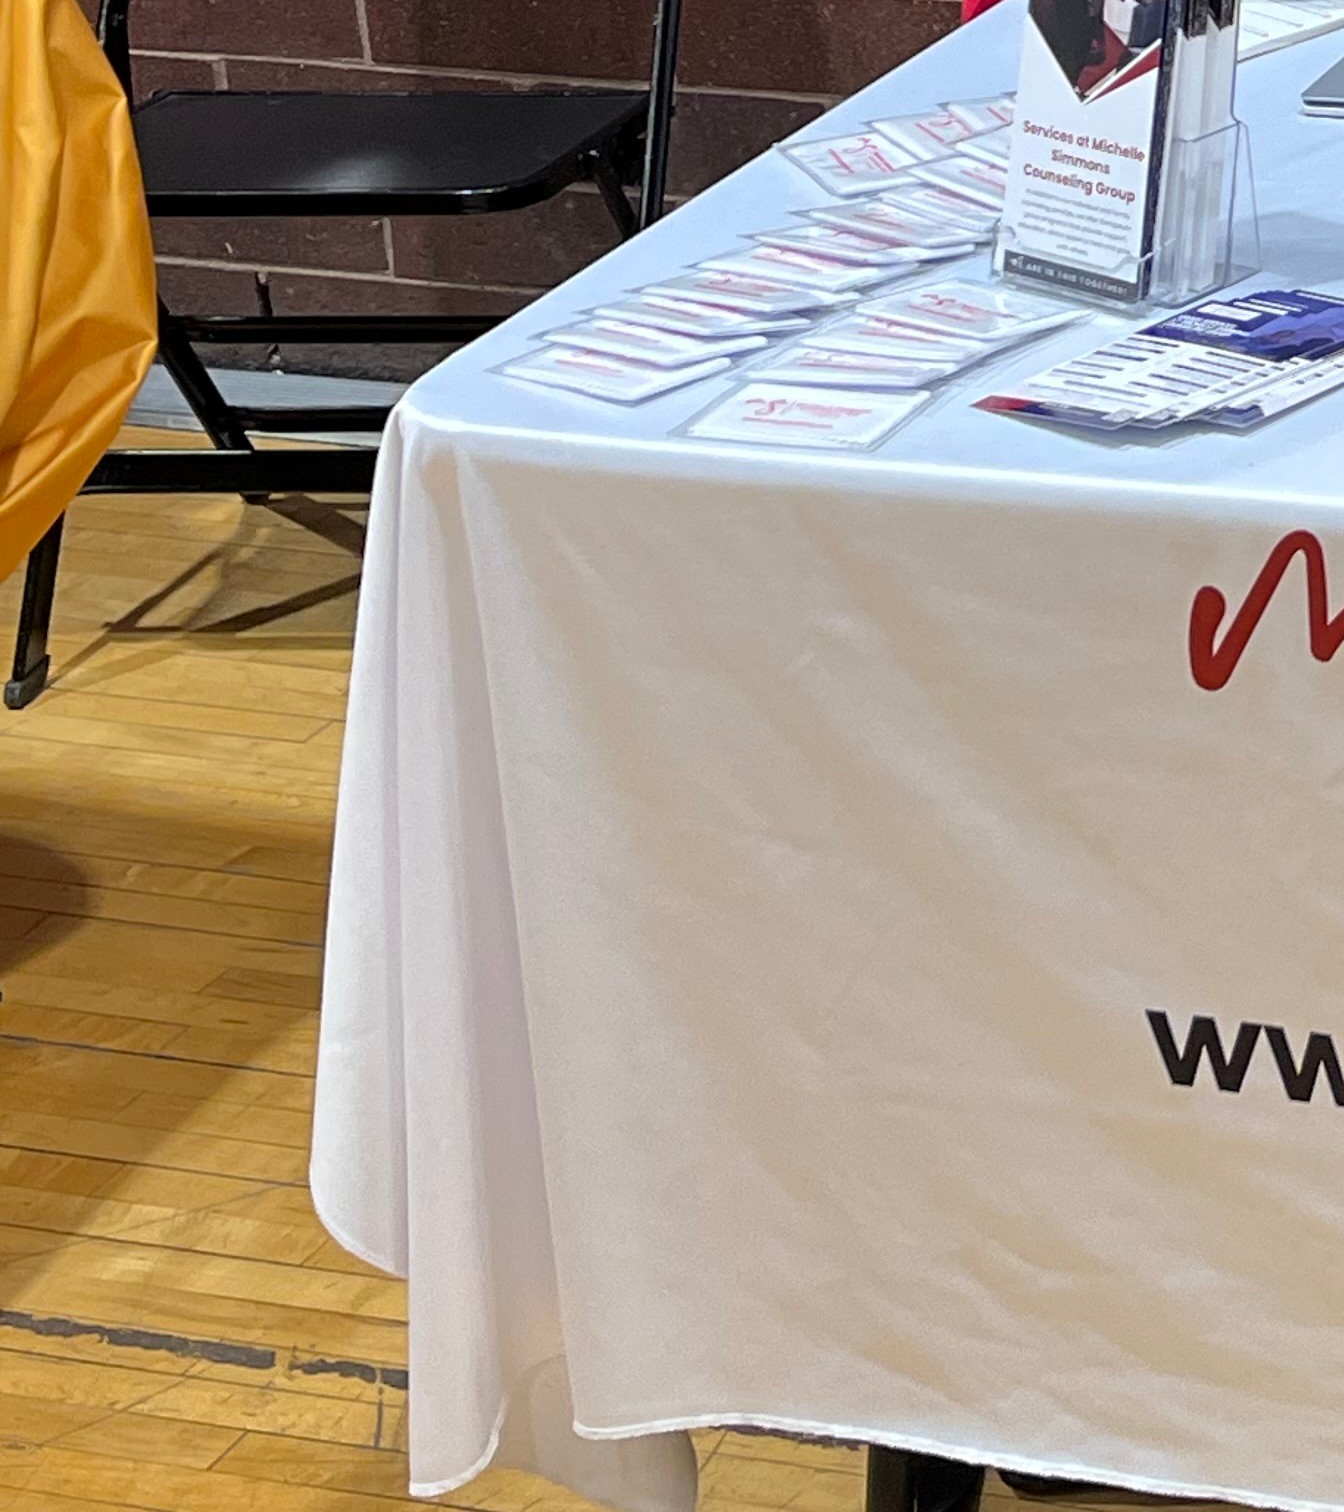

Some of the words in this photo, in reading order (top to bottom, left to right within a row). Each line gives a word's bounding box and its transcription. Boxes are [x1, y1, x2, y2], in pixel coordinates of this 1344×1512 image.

[1023, 120, 1073, 144] Services
[1077, 135, 1089, 147] at
[1092, 138, 1145, 162] Michelle
[1052, 149, 1110, 174] Simmons
[1024, 163, 1093, 195] Counseling
[1096, 182, 1135, 205] Group
